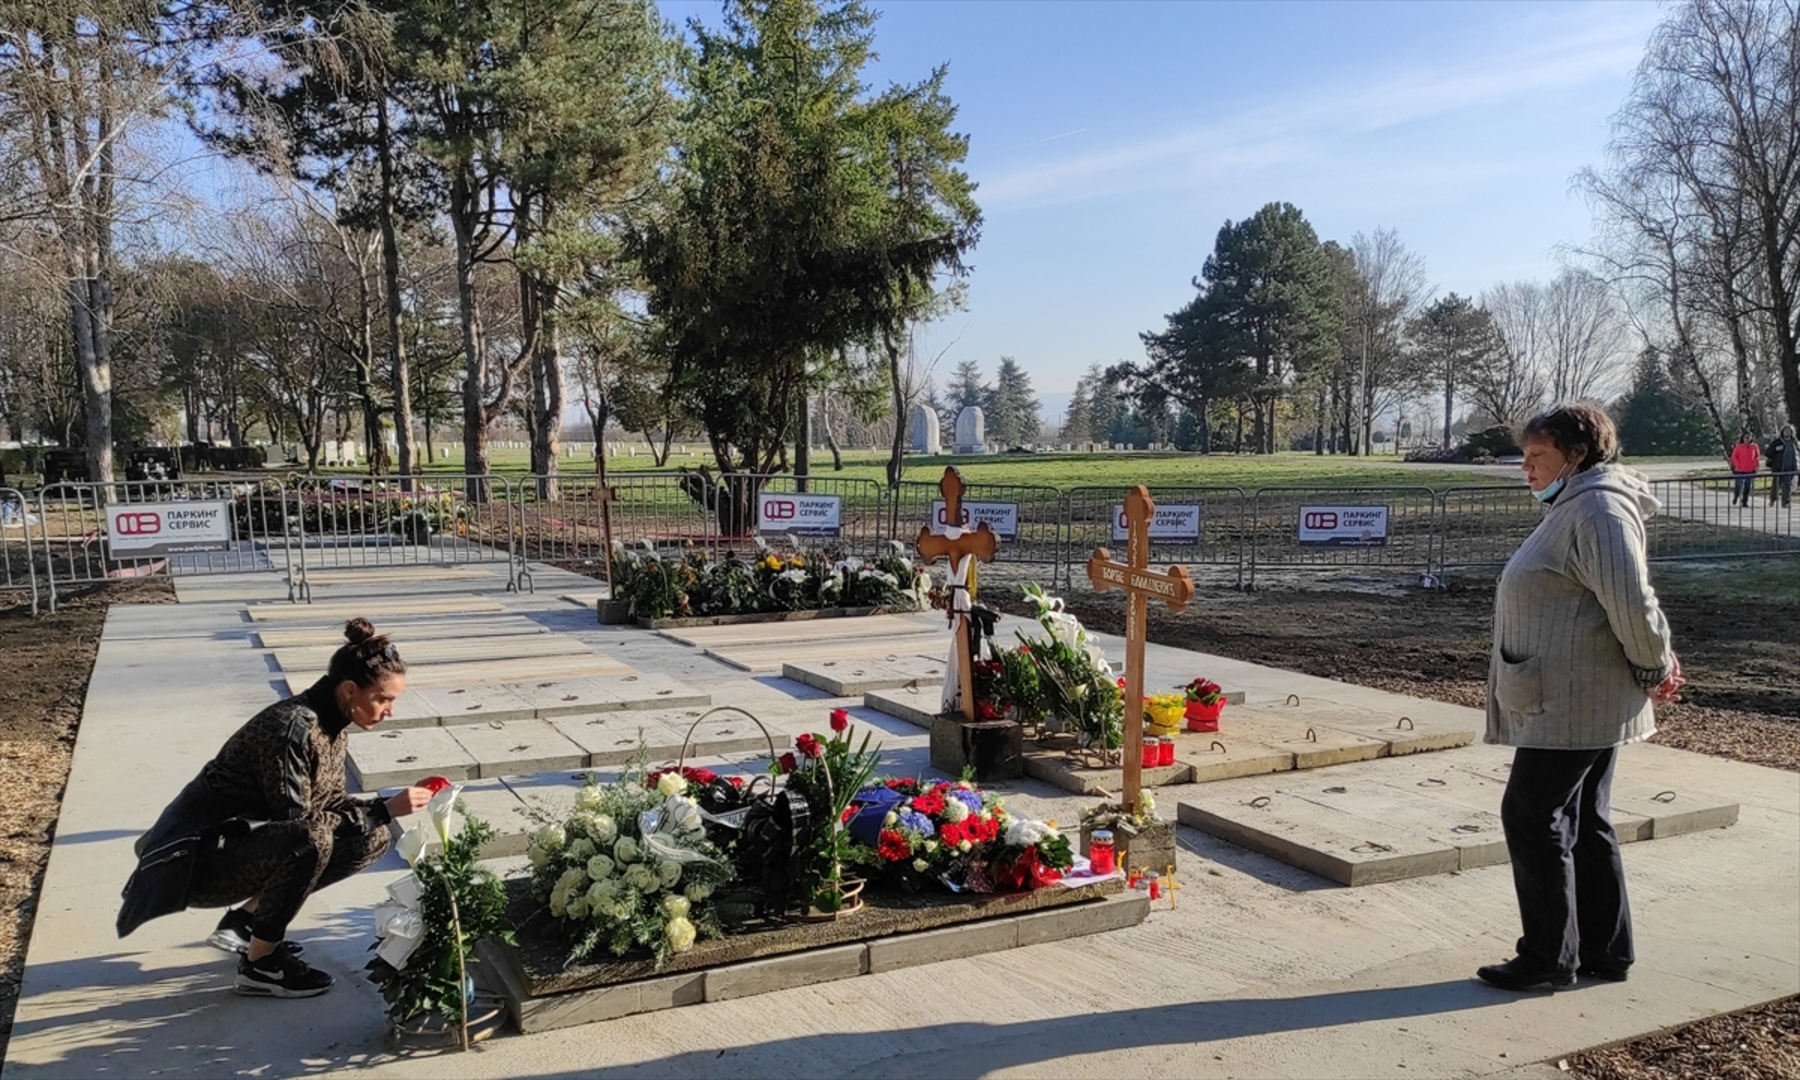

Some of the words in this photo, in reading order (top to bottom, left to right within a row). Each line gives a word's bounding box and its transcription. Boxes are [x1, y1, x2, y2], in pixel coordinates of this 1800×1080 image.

[799, 501, 835, 509] ПАРКИНГ
[167, 509, 219, 520] ПАРКИНГ
[799, 509, 828, 517] СЕРВИС
[974, 508, 1012, 516] ПАРКИНГ
[1156, 510, 1194, 518] ПАРКИНГ
[1343, 510, 1382, 519] ПАРКИНГ
[974, 516, 1006, 524] СЕРВИС
[1156, 518, 1187, 526] СЕРВИС
[1343, 519, 1375, 527] СЕРВИС
[168, 520, 211, 530] СЕРВИС
